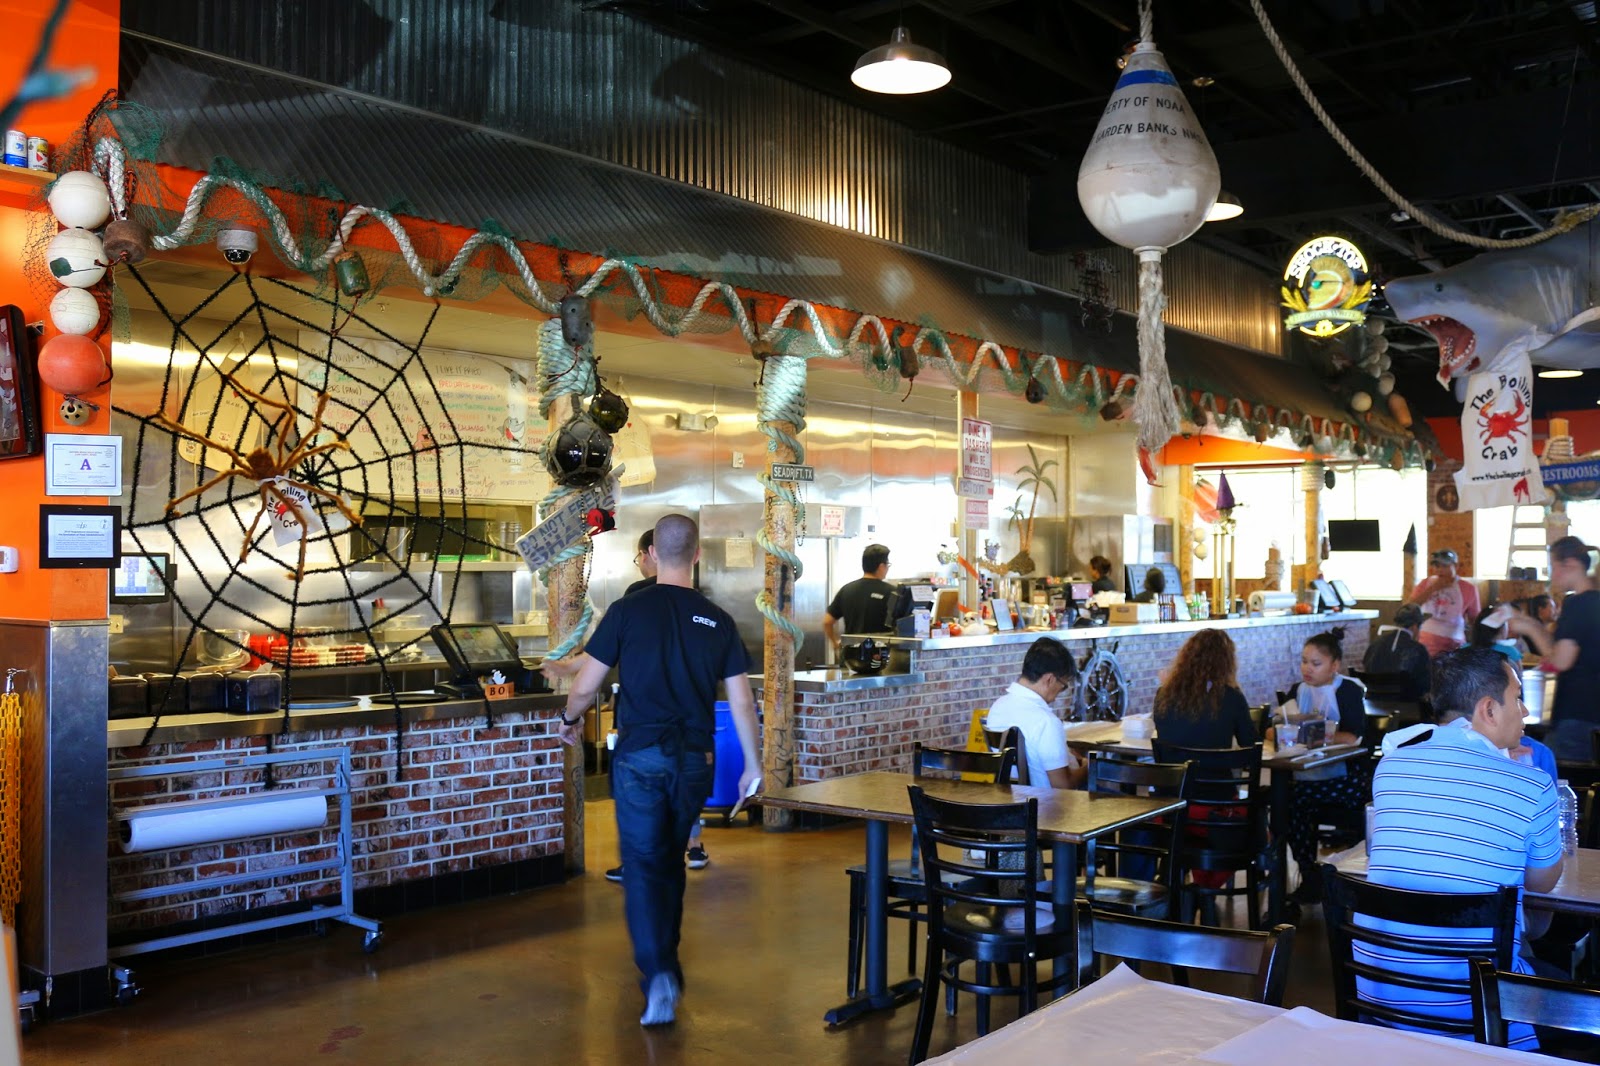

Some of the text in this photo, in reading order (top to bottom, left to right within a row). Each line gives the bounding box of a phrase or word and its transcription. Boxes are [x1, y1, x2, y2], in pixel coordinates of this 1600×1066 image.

[1133, 96, 1150, 107] OF
[1137, 122, 1178, 136] BANKS
[440, 365, 454, 374] LIKE
[1470, 388, 1494, 410] The
[1482, 445, 1518, 461] Crab
[80, 459, 92, 470] A
[280, 486, 306, 502] oiling
[282, 519, 299, 528] Cra
[538, 511, 565, 541] NOT
[692, 615, 717, 628] CREW
